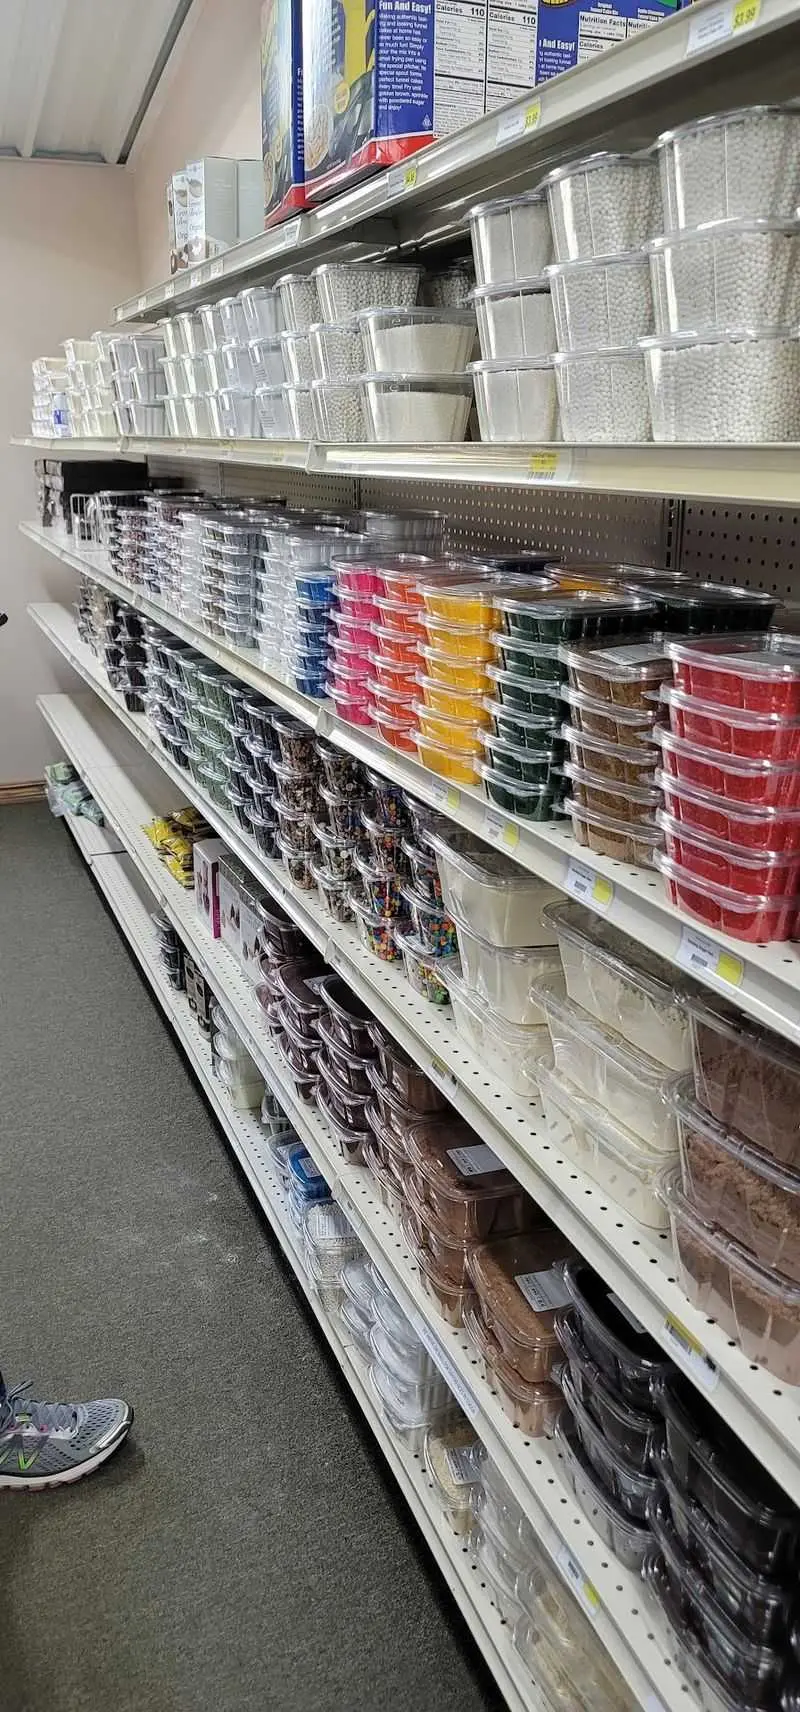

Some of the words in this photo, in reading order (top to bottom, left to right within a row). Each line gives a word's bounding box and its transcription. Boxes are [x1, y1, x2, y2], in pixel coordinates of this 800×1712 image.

[379, 1, 393, 10] Fun
[394, 1, 410, 11] And
[411, 2, 431, 15] Easy!
[436, 4, 463, 13] Calories
[471, 7, 485, 17] 110
[489, 11, 515, 21] Calories
[522, 16, 536, 25] 110
[580, 15, 608, 25] Nutrition
[609, 18, 627, 27] Facts
[542, 38, 557, 49] And
[557, 40, 575, 51] Easy!
[579, 41, 604, 49] Calories
